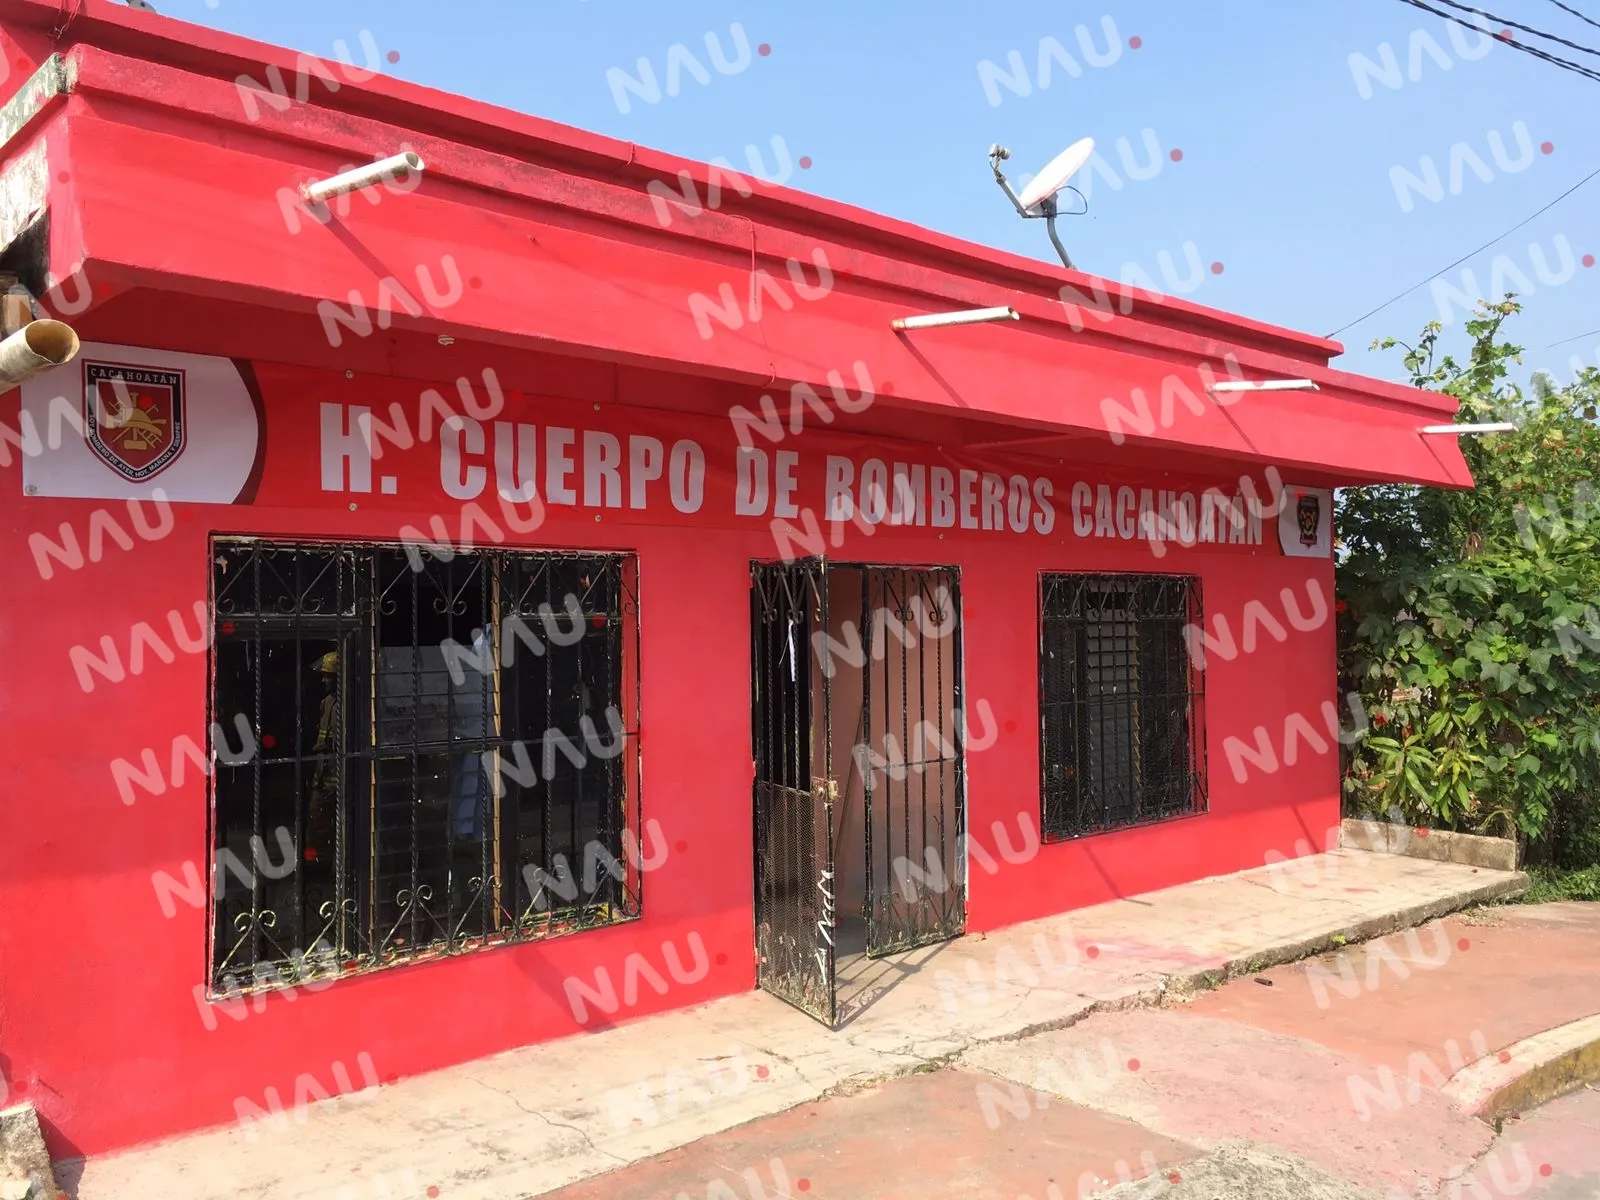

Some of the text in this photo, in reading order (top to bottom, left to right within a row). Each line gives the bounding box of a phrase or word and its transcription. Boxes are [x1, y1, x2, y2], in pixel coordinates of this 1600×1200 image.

[320, 402, 1263, 545] H. CUERPO DE BOMBEROS CACAHOATÁN
